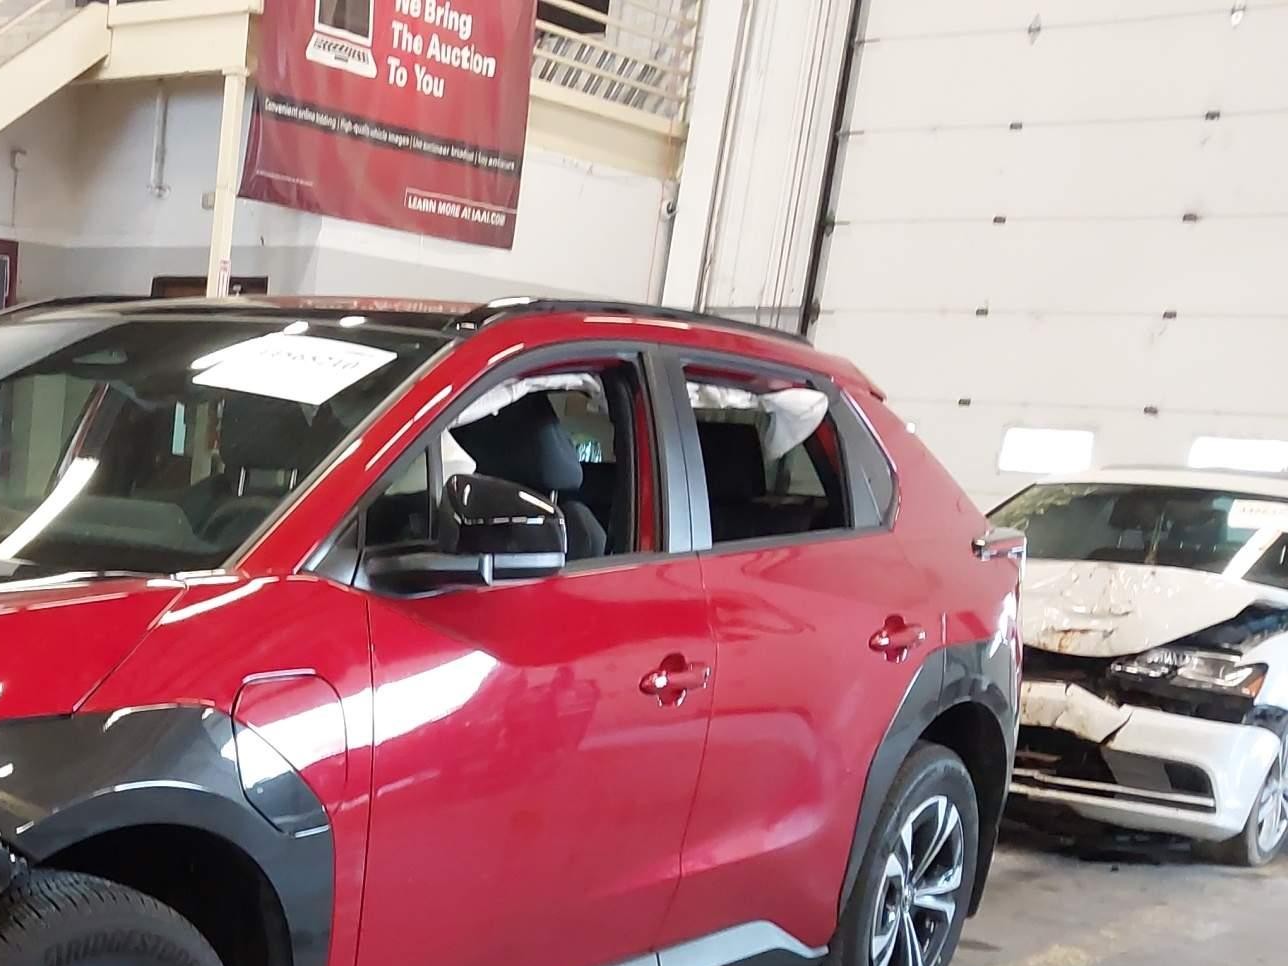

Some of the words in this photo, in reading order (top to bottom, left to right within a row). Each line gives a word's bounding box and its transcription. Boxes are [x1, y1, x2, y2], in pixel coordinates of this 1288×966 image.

[424, 0, 473, 41] Bring
[391, 20, 424, 55] The
[426, 33, 497, 78] Auction
[387, 56, 408, 88] To
[414, 63, 445, 98] You
[408, 195, 437, 214] LEARN
[437, 201, 461, 218] MORE
[461, 206, 471, 220] AT
